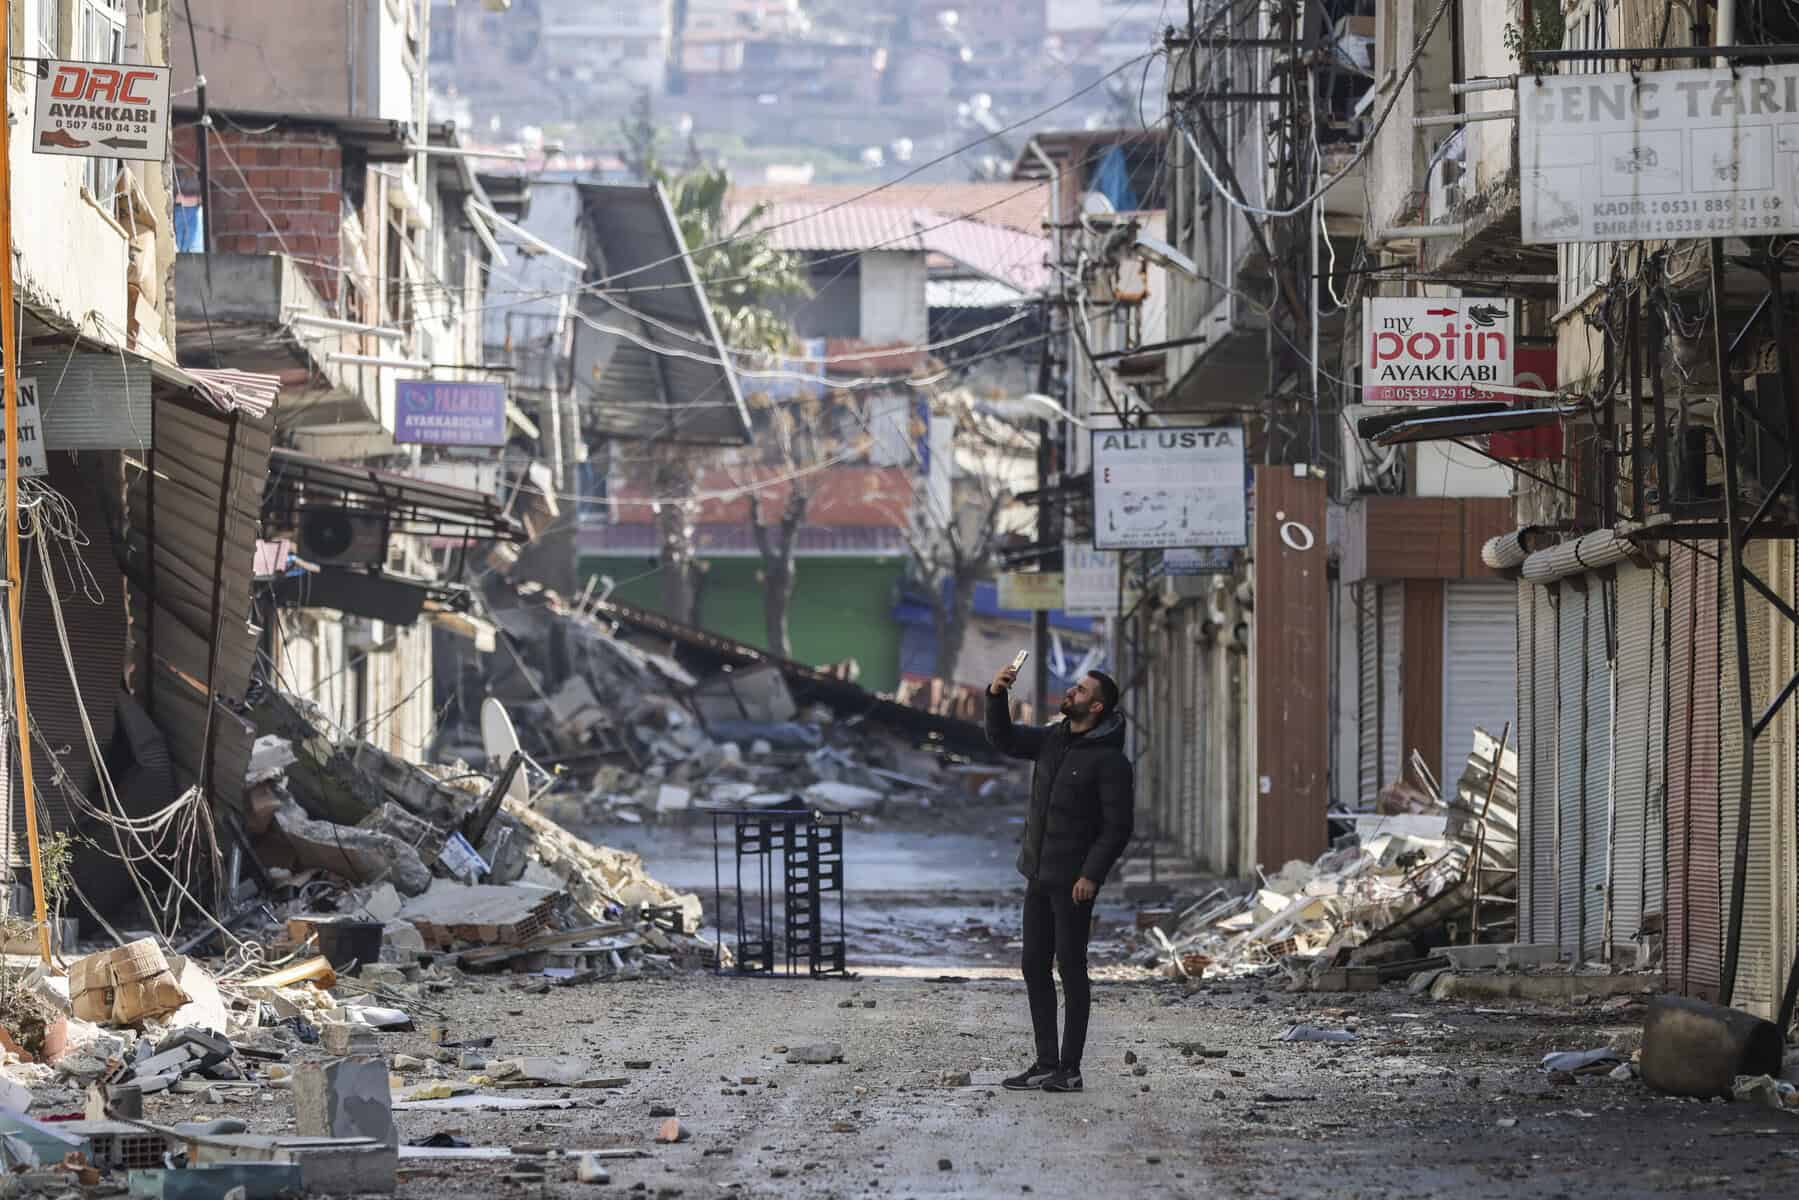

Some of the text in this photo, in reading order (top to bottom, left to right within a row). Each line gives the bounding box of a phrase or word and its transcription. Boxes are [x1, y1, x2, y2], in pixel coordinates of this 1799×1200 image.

[51, 66, 158, 105] DRC
[48, 103, 156, 123] AYAKKABI
[55, 120, 148, 134] 0 507 450 84 34
[1661, 199, 1697, 214] 0531
[1384, 316, 1415, 334] my
[1371, 323, 1507, 369] potin
[1381, 364, 1497, 381] AYAKKABI
[1396, 387, 1430, 400] 0539
[1431, 387, 1457, 399] 429
[1158, 431, 1234, 449] USTA
